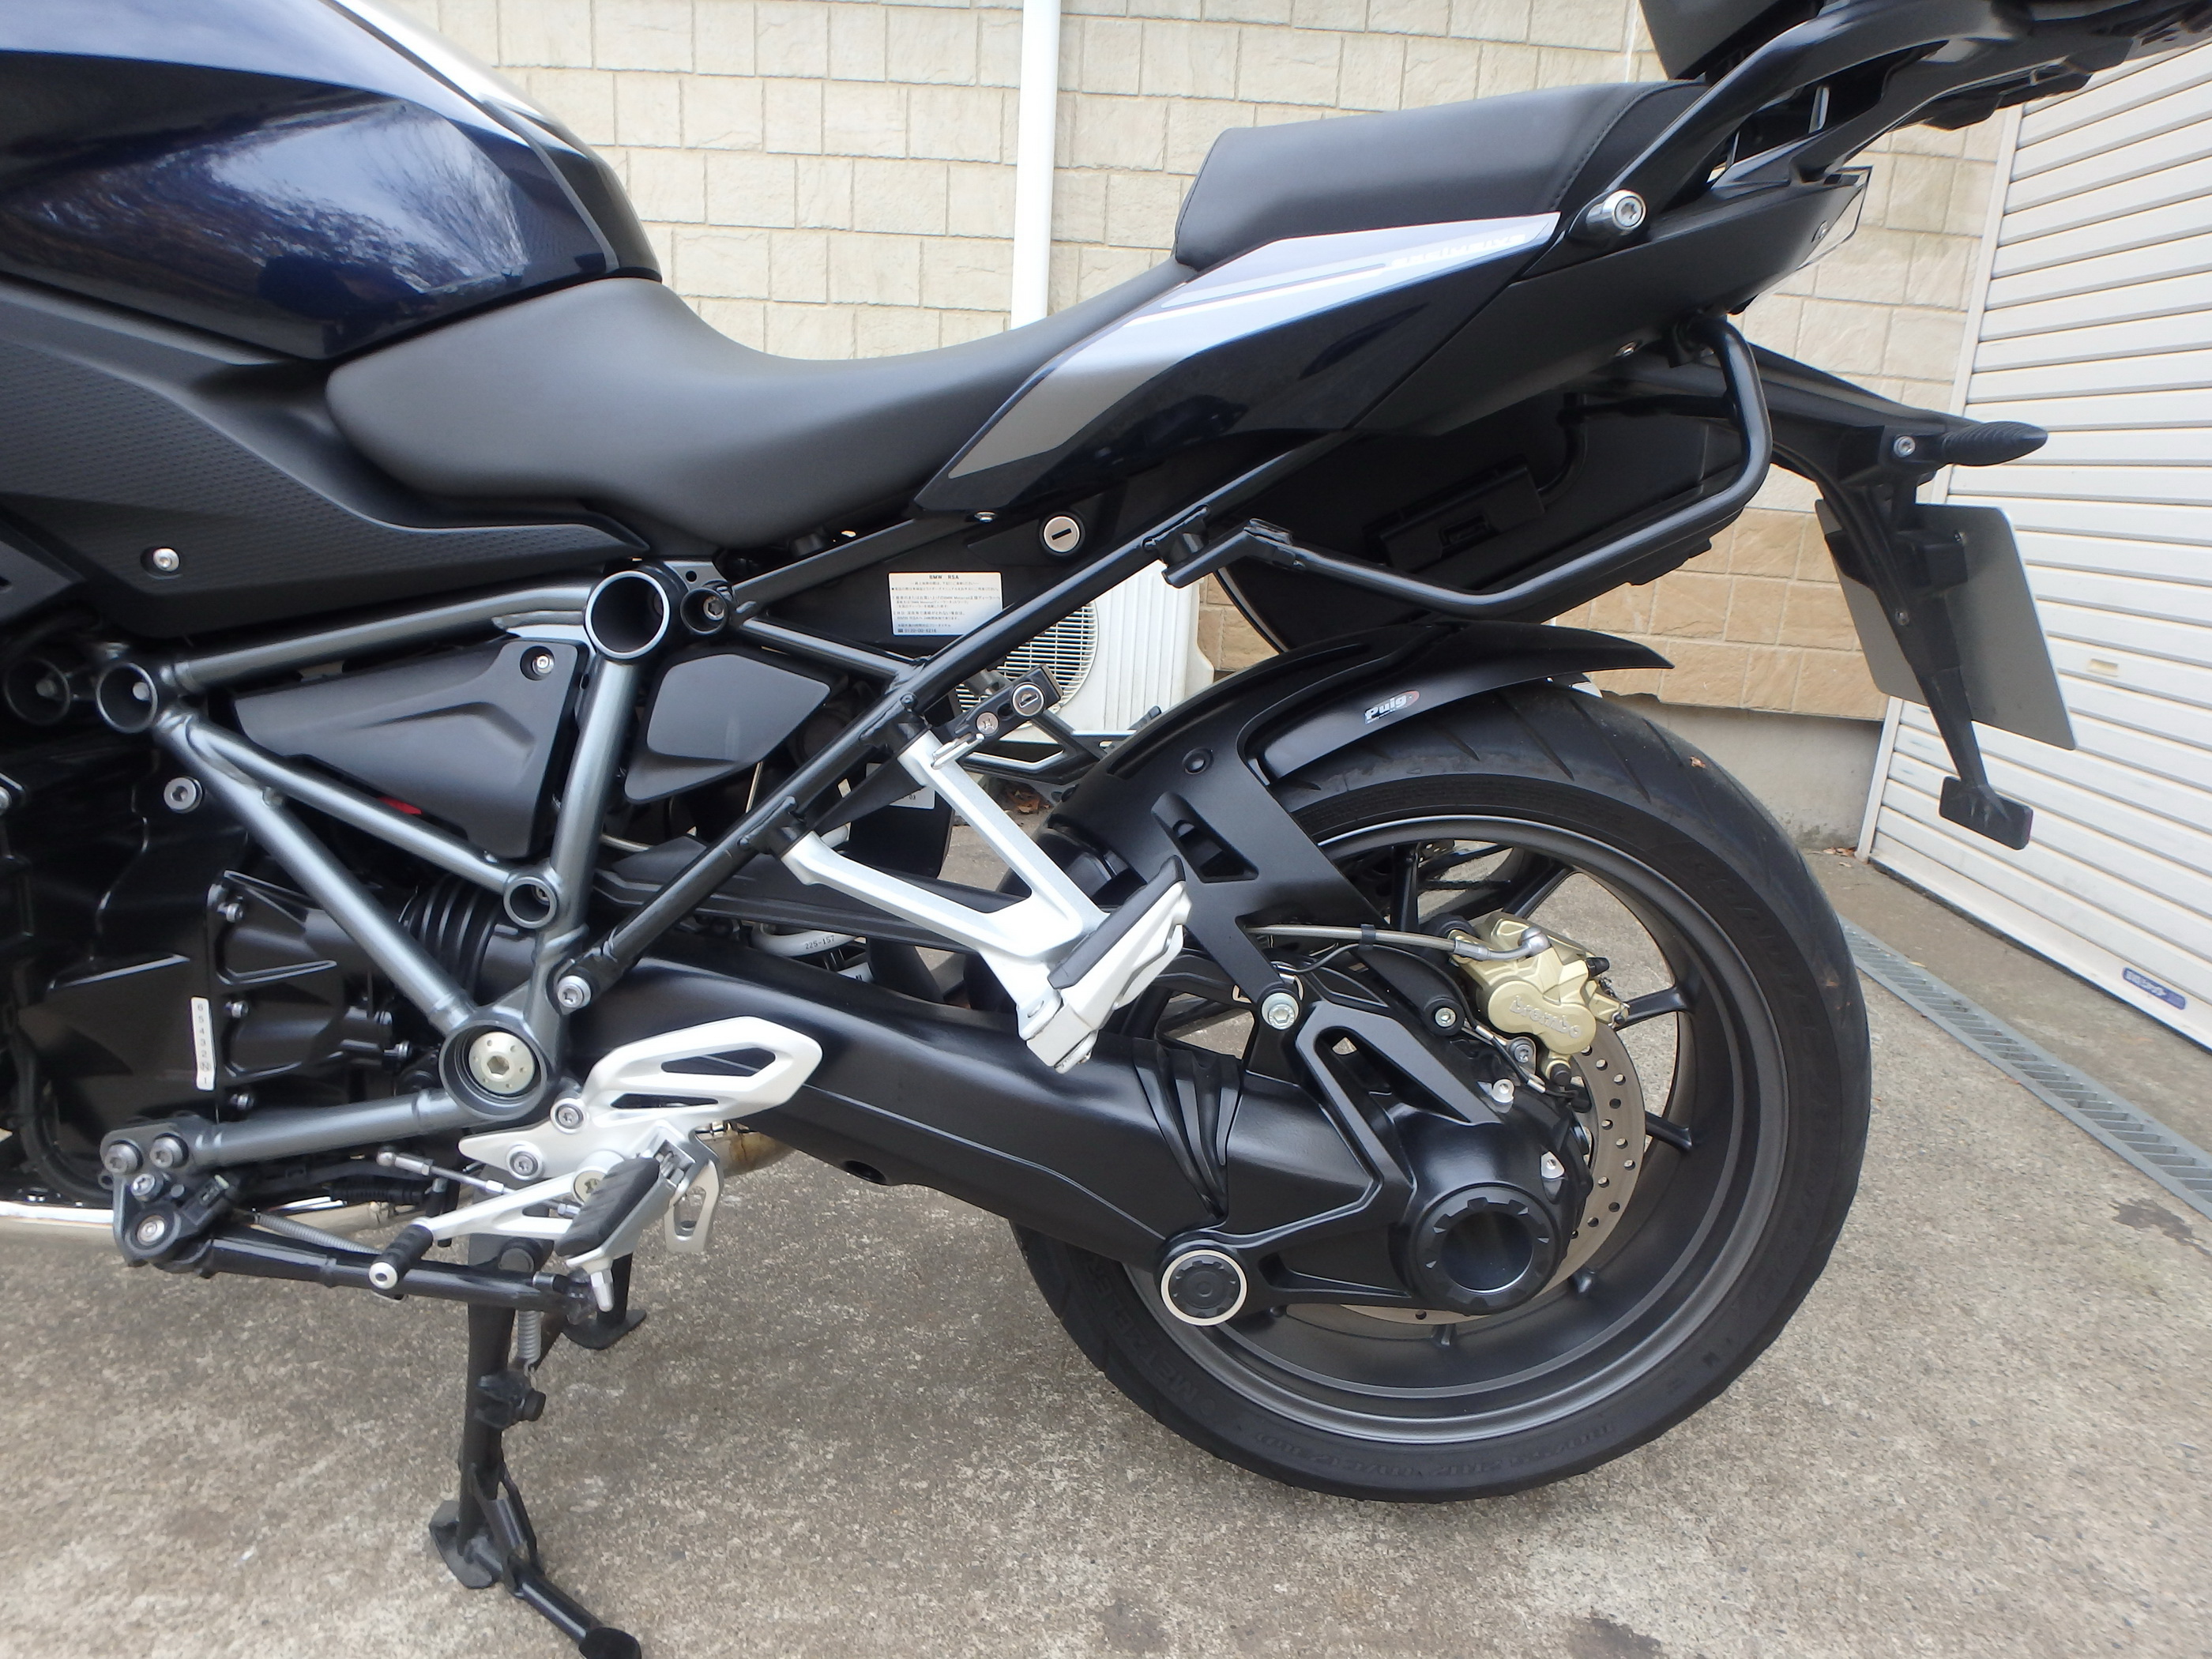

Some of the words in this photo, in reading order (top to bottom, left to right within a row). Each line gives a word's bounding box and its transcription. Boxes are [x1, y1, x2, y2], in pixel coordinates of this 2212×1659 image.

[1364, 695, 1406, 720] Puig
[804, 935, 835, 950] 225-157
[1509, 995, 1582, 1039] brembo
